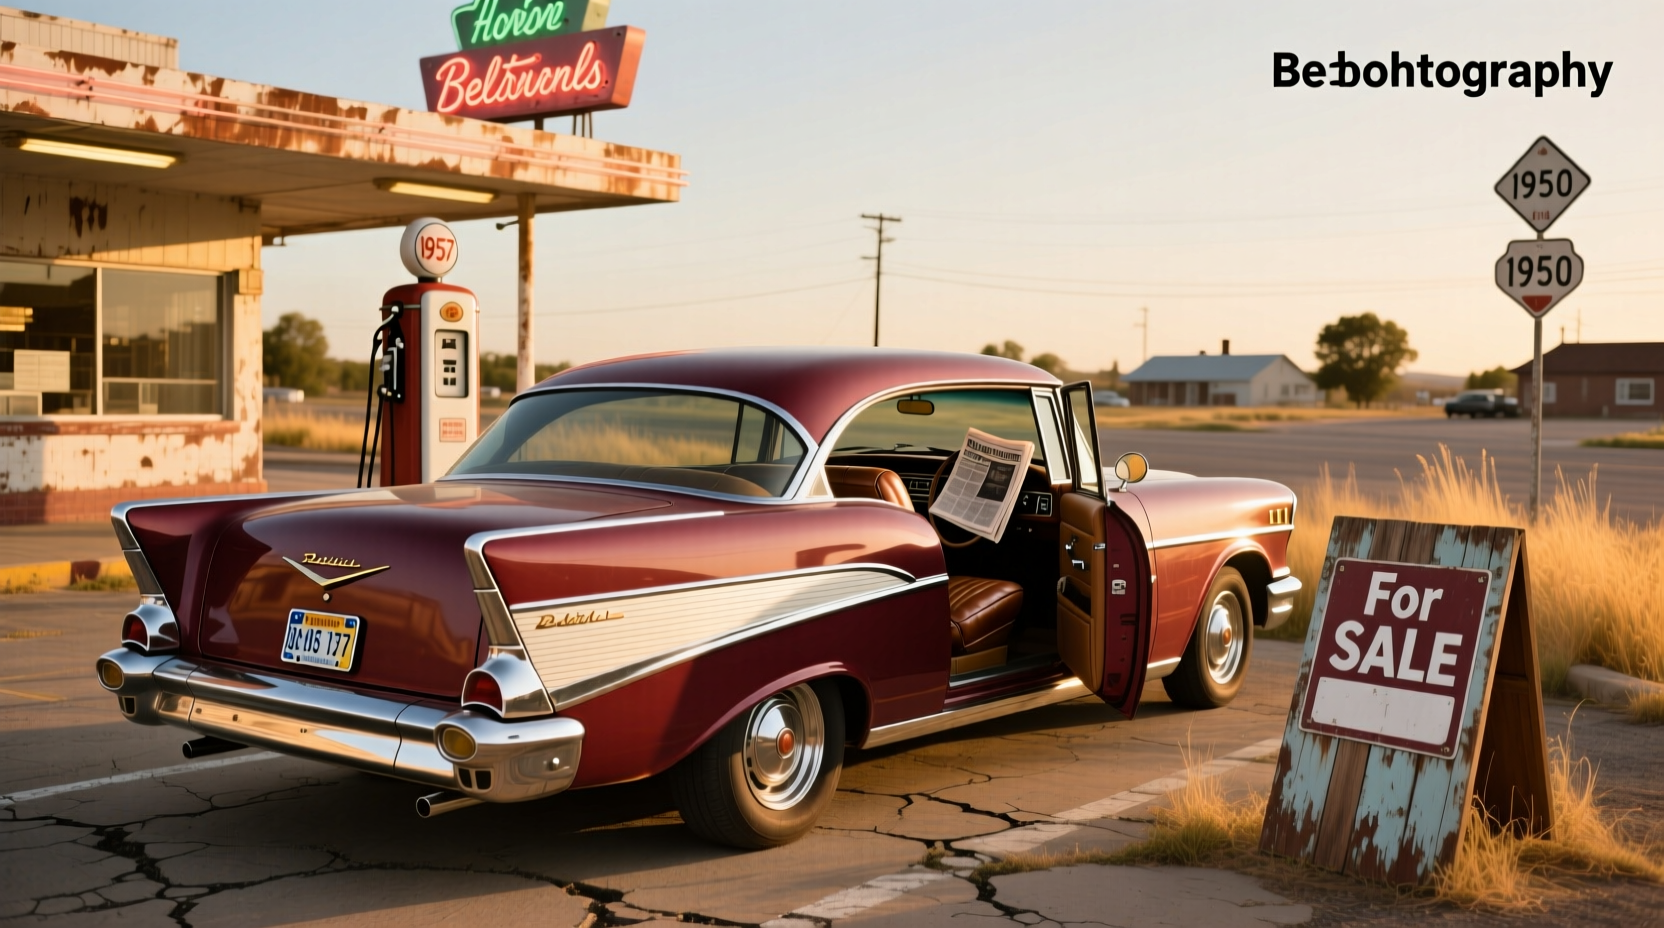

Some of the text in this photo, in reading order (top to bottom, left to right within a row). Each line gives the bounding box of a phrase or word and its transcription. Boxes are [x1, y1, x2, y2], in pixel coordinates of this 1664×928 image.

[1512, 168, 1573, 200] 1950
[420, 235, 455, 262] 1957
[1506, 255, 1573, 288] 1950
[1363, 570, 1444, 622] For
[1328, 619, 1464, 688] SALE
